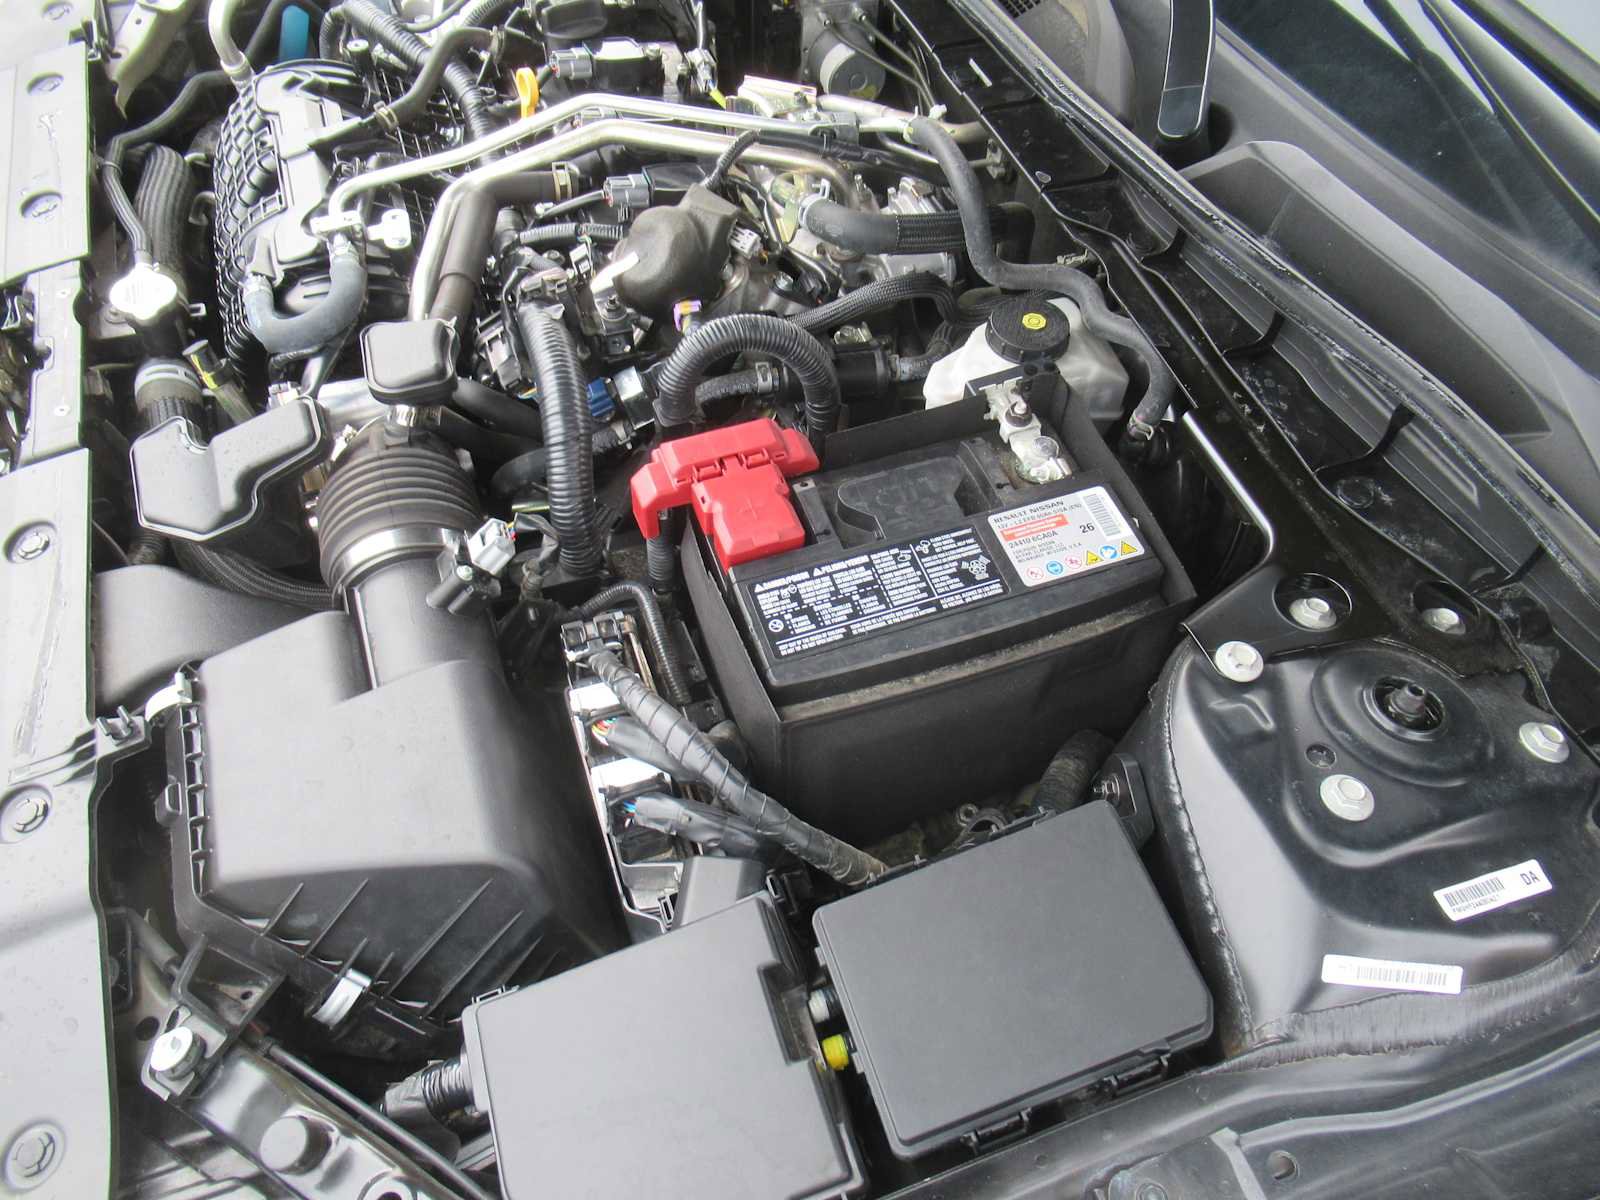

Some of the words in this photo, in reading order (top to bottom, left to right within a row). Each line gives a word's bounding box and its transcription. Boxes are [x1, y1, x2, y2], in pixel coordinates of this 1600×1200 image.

[993, 510, 1027, 523] RENAULT
[1029, 500, 1063, 513] NISSAN
[1079, 523, 1095, 533] 26
[1520, 871, 1541, 886] DA
